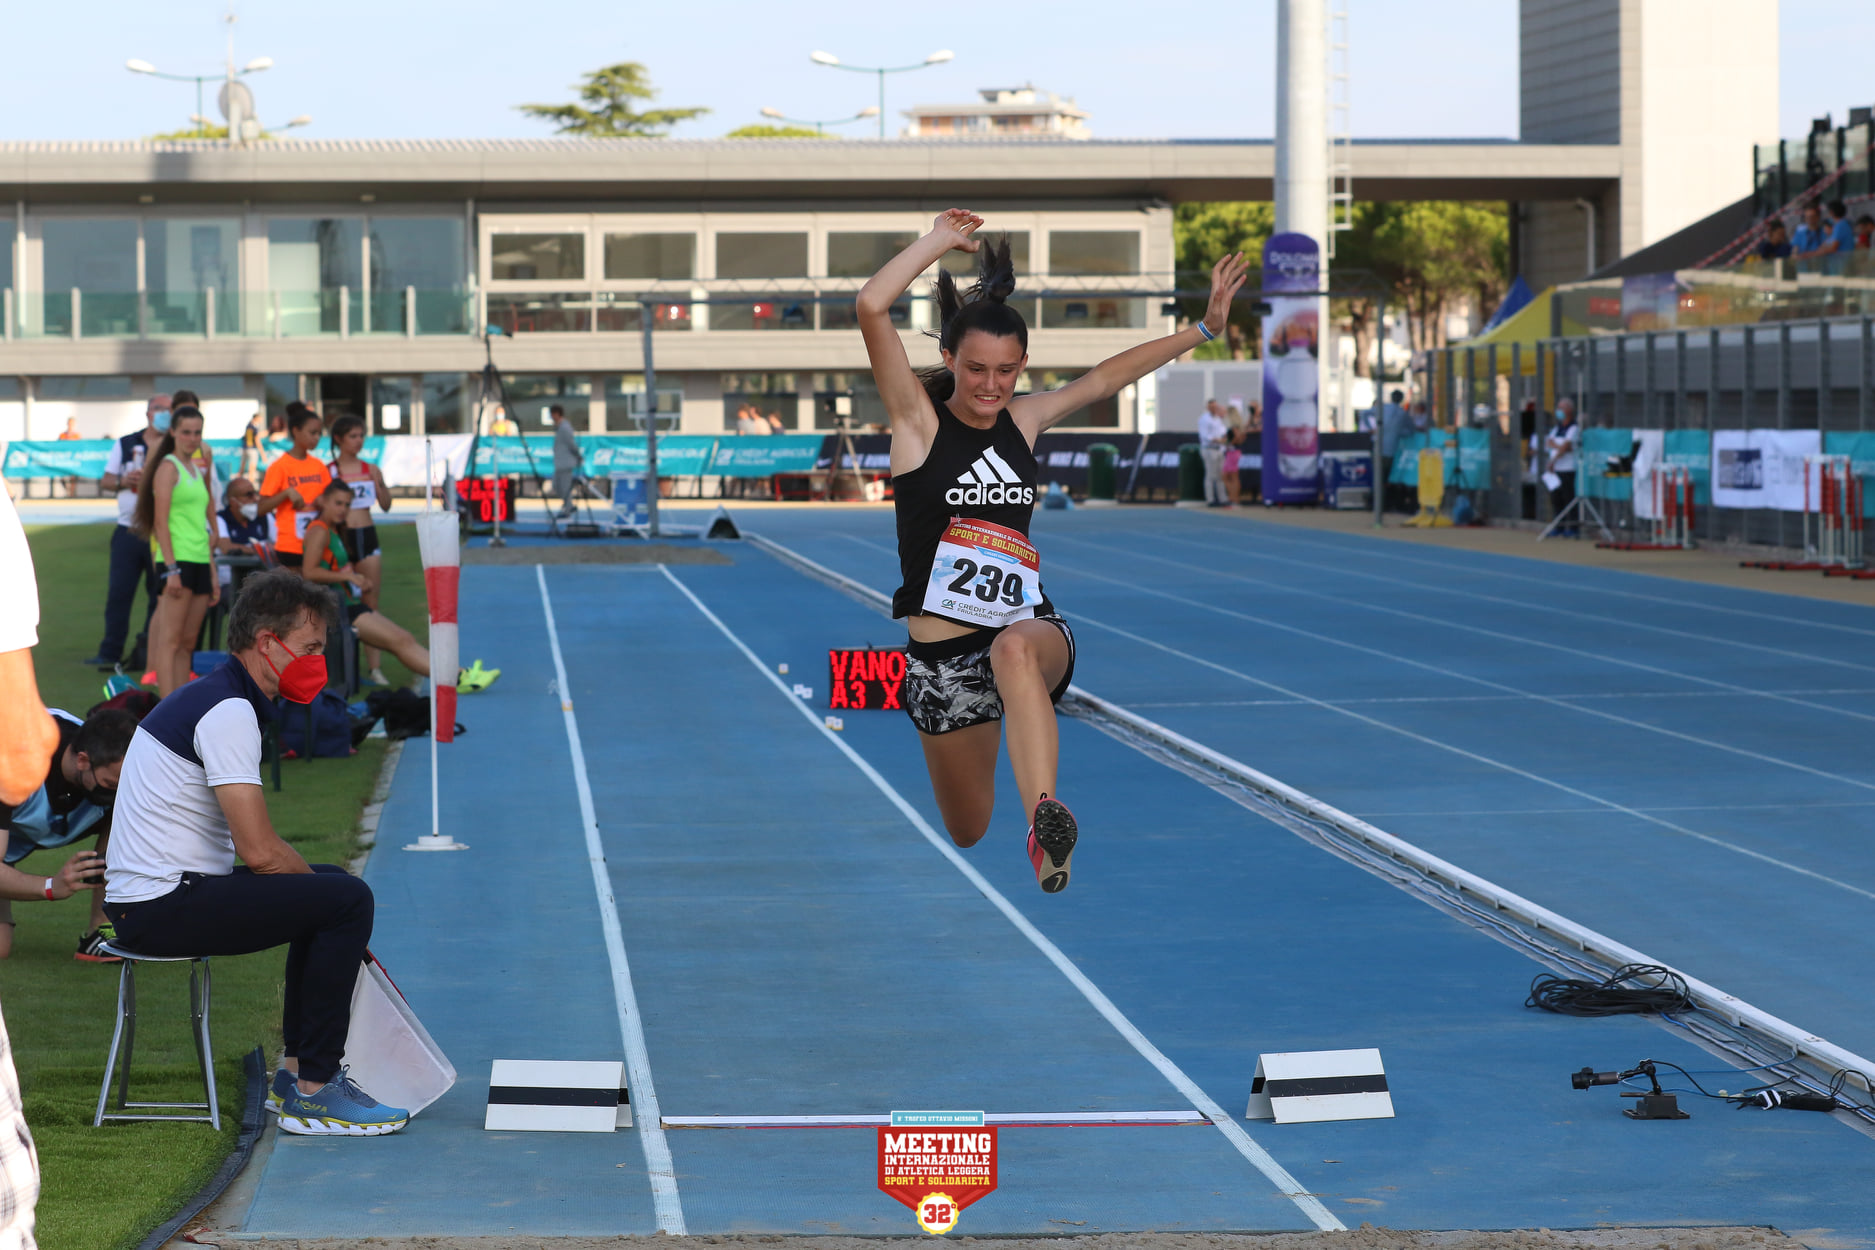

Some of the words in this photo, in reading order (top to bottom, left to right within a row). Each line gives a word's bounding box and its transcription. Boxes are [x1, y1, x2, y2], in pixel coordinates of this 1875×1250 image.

[945, 482, 1034, 506] adidas
[949, 527, 981, 542] SPORT
[982, 536, 990, 544] E
[947, 558, 1025, 607] 239
[829, 680, 866, 710] A3
[881, 681, 901, 711] X
